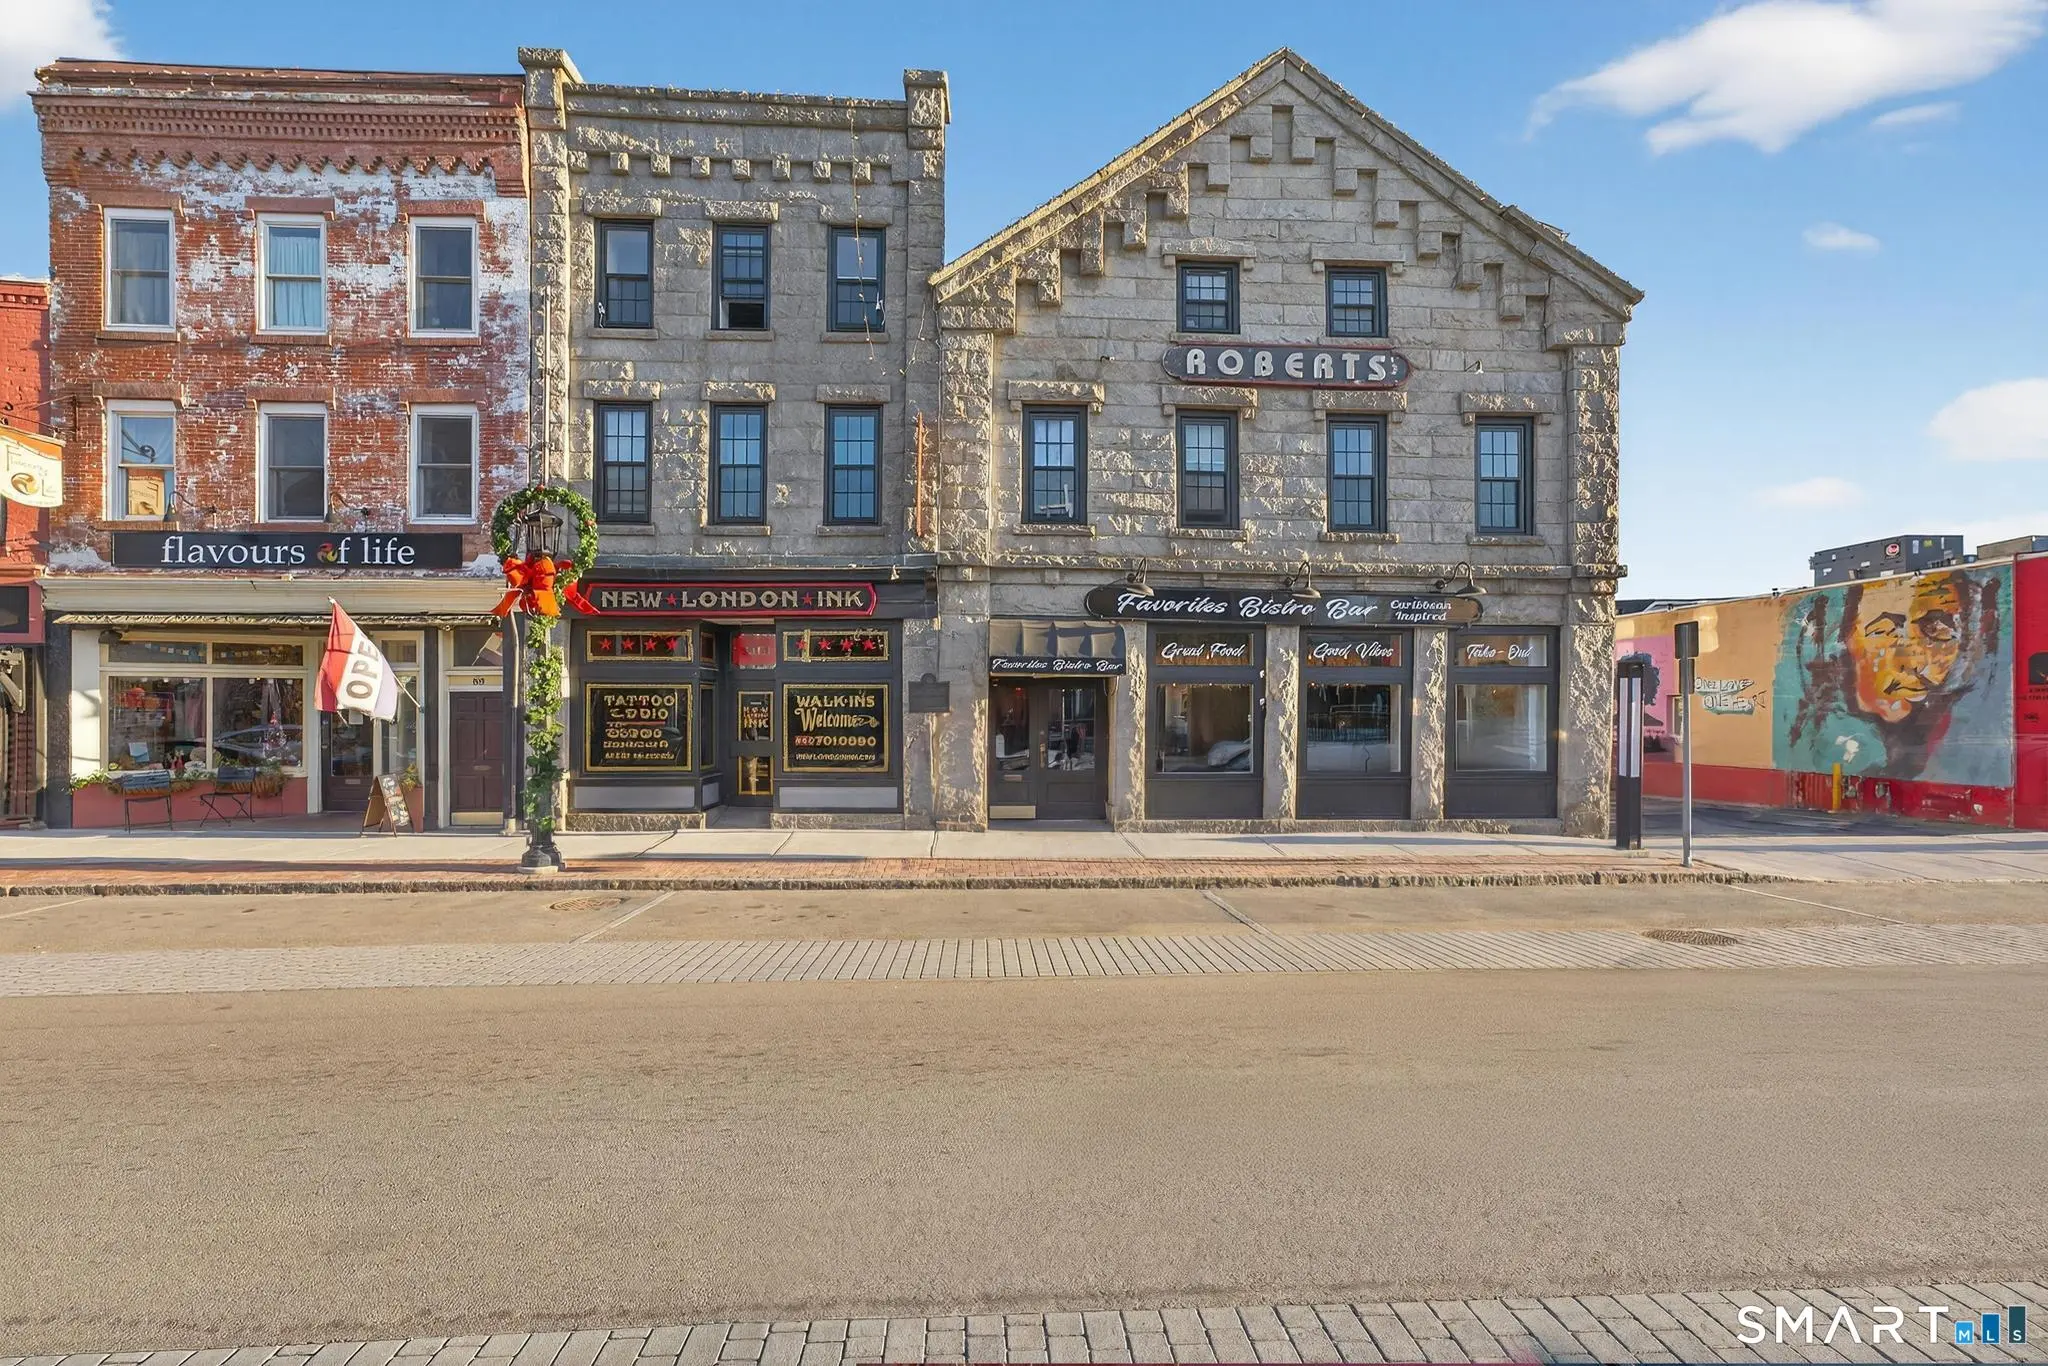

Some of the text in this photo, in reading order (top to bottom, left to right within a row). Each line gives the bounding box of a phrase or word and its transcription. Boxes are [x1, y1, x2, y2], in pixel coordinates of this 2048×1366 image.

[1186, 349, 1386, 380] ROBERTS
[161, 536, 305, 565] flavours
[361, 537, 415, 565] life
[601, 591, 864, 608] NEW LONDON INK
[1117, 593, 1378, 619] Favorites Bistro Bar
[1395, 611, 1447, 622] Inspired
[1210, 643, 1246, 659] Food
[1313, 642, 1352, 662] Good
[346, 633, 379, 699] OPE
[603, 695, 675, 706] TATTOO
[794, 707, 866, 732] Welcome
